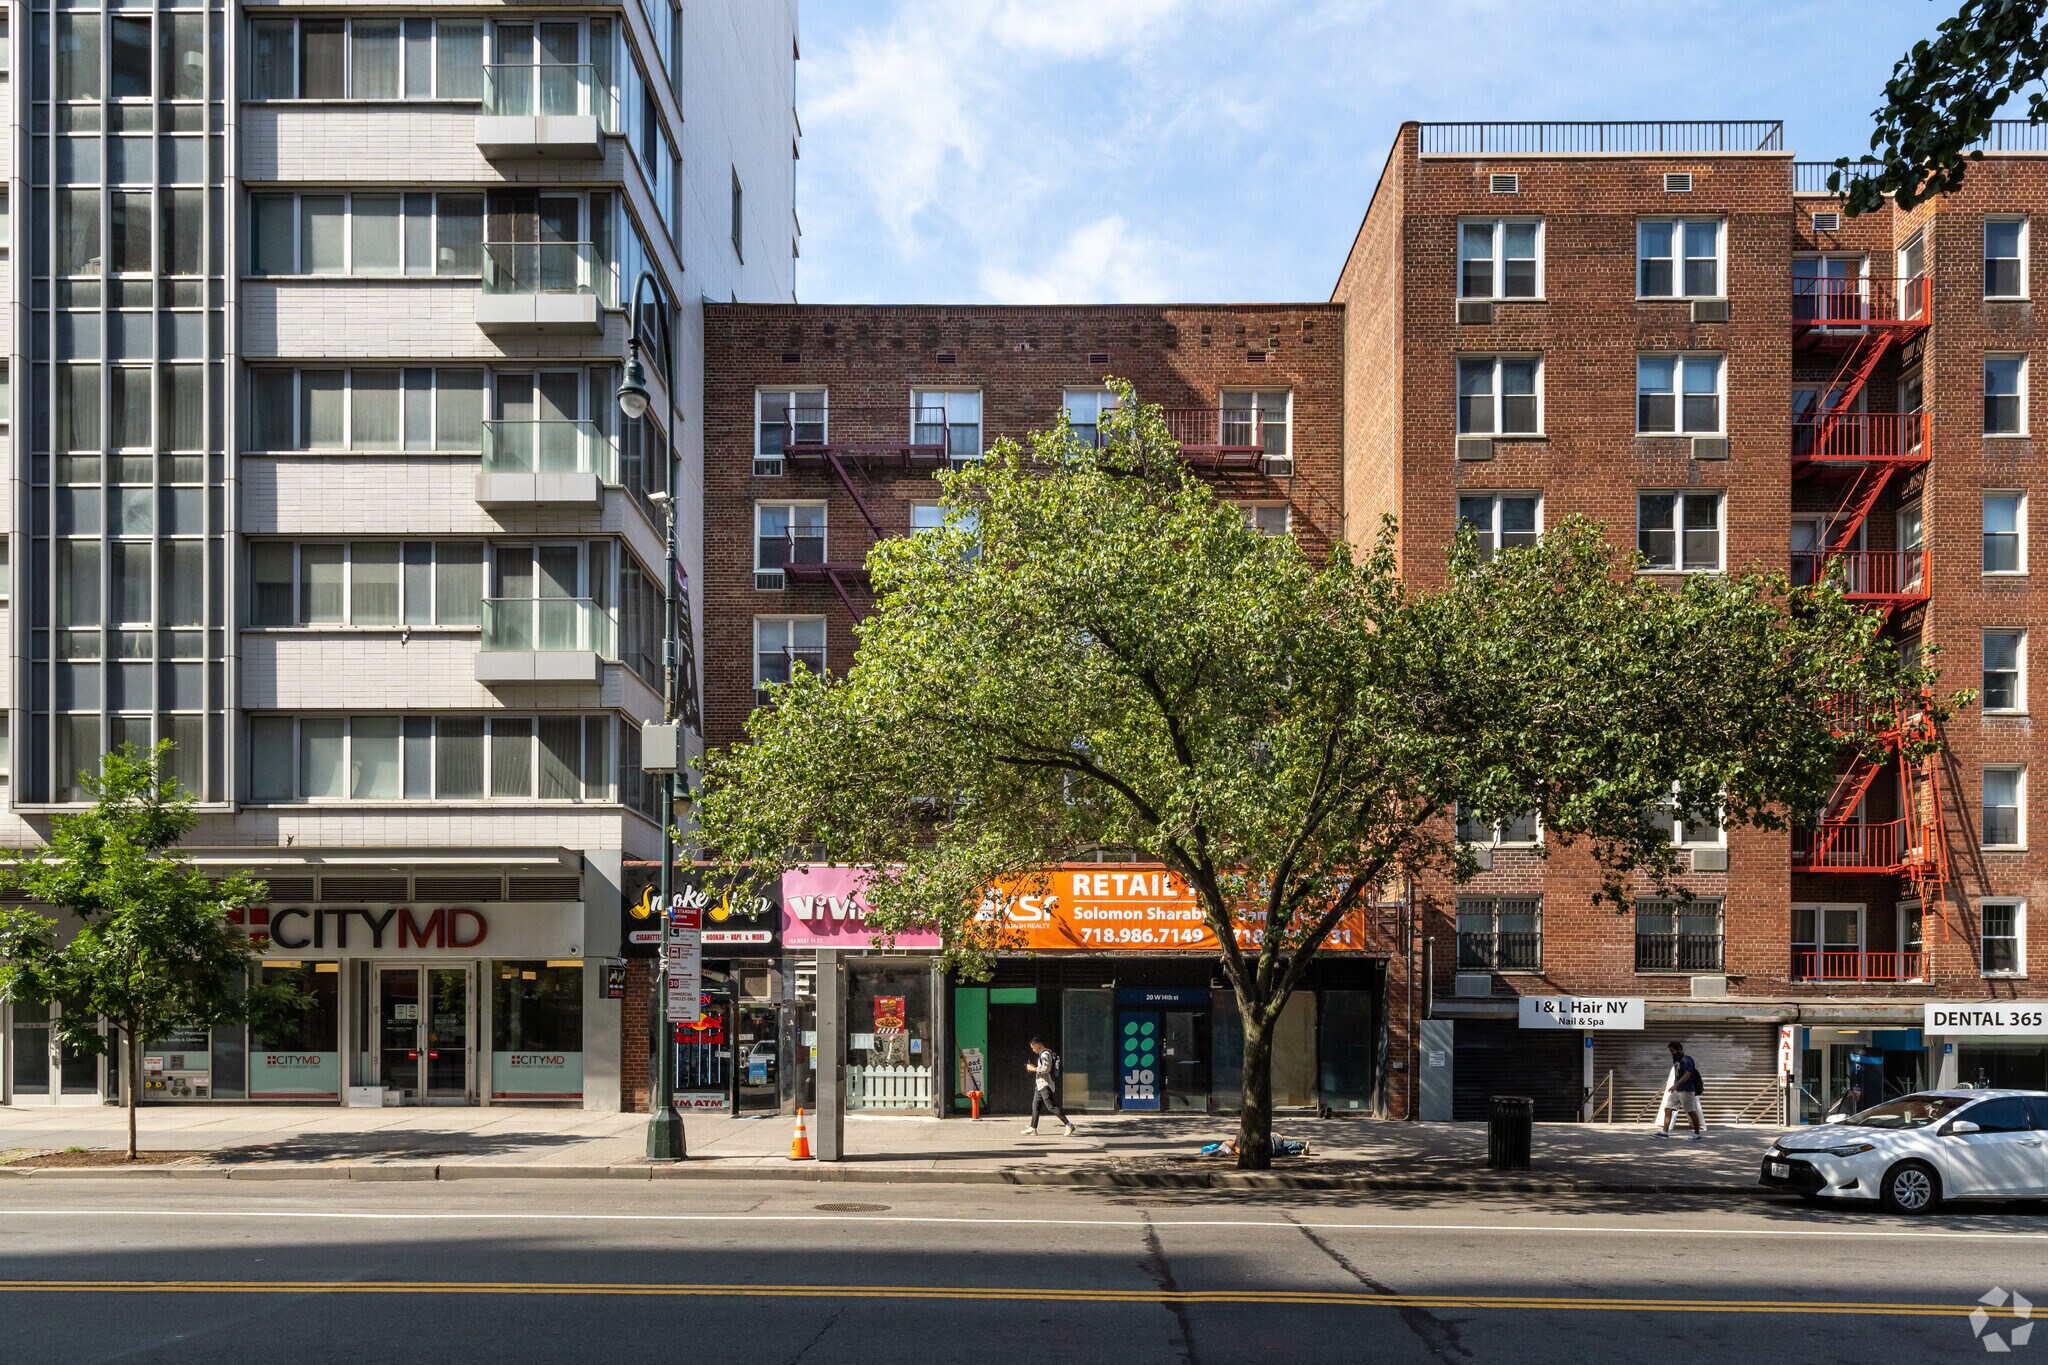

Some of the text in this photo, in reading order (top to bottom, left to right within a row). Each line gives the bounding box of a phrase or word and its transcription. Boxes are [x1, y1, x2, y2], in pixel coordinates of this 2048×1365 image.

[1073, 874, 1177, 896] RETAIL
[1073, 907, 1207, 923] Solomon Sharaby
[270, 908, 488, 949] CITYMD
[1081, 928, 1204, 943] 718.986.7149
[1535, 1001, 1628, 1014] I & L Hair NY
[1558, 1017, 1577, 1025] Nail
[1587, 1018, 1604, 1027] Spa
[1934, 1012, 2042, 1026] DENTAL 365
[675, 1032, 724, 1044] Red Bull
[1781, 1030, 1791, 1071] NAIL
[276, 1056, 321, 1064] CITYMD
[520, 1056, 565, 1064] CITYMD
[1125, 1070, 1154, 1084] JO
[1125, 1085, 1154, 1099] KR
